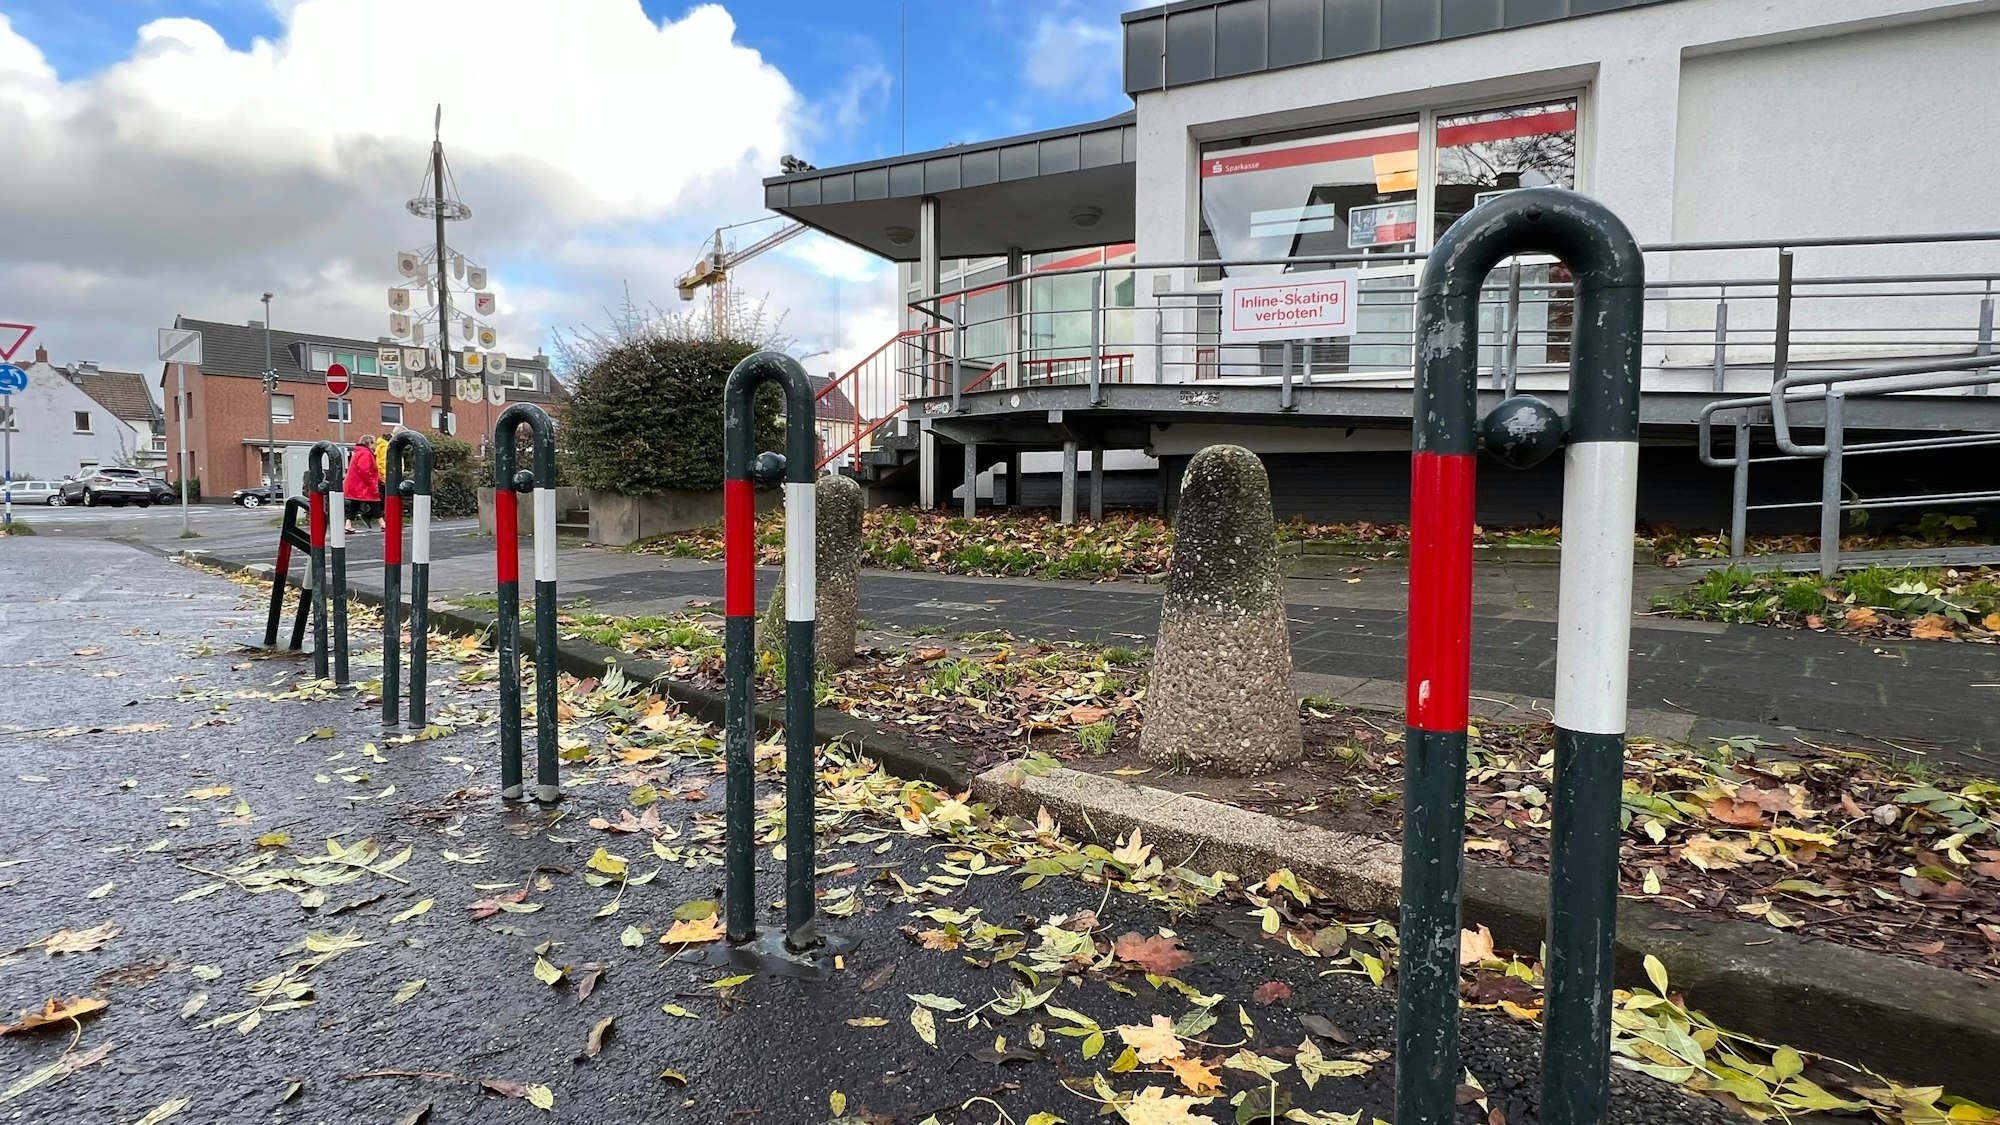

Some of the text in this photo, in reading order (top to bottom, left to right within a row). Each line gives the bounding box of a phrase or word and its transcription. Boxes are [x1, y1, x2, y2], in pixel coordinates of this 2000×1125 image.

[1225, 162, 1260, 173] Sparkasse
[1241, 291, 1339, 308] Inline-Skating
[1255, 305, 1323, 321] verboten!
